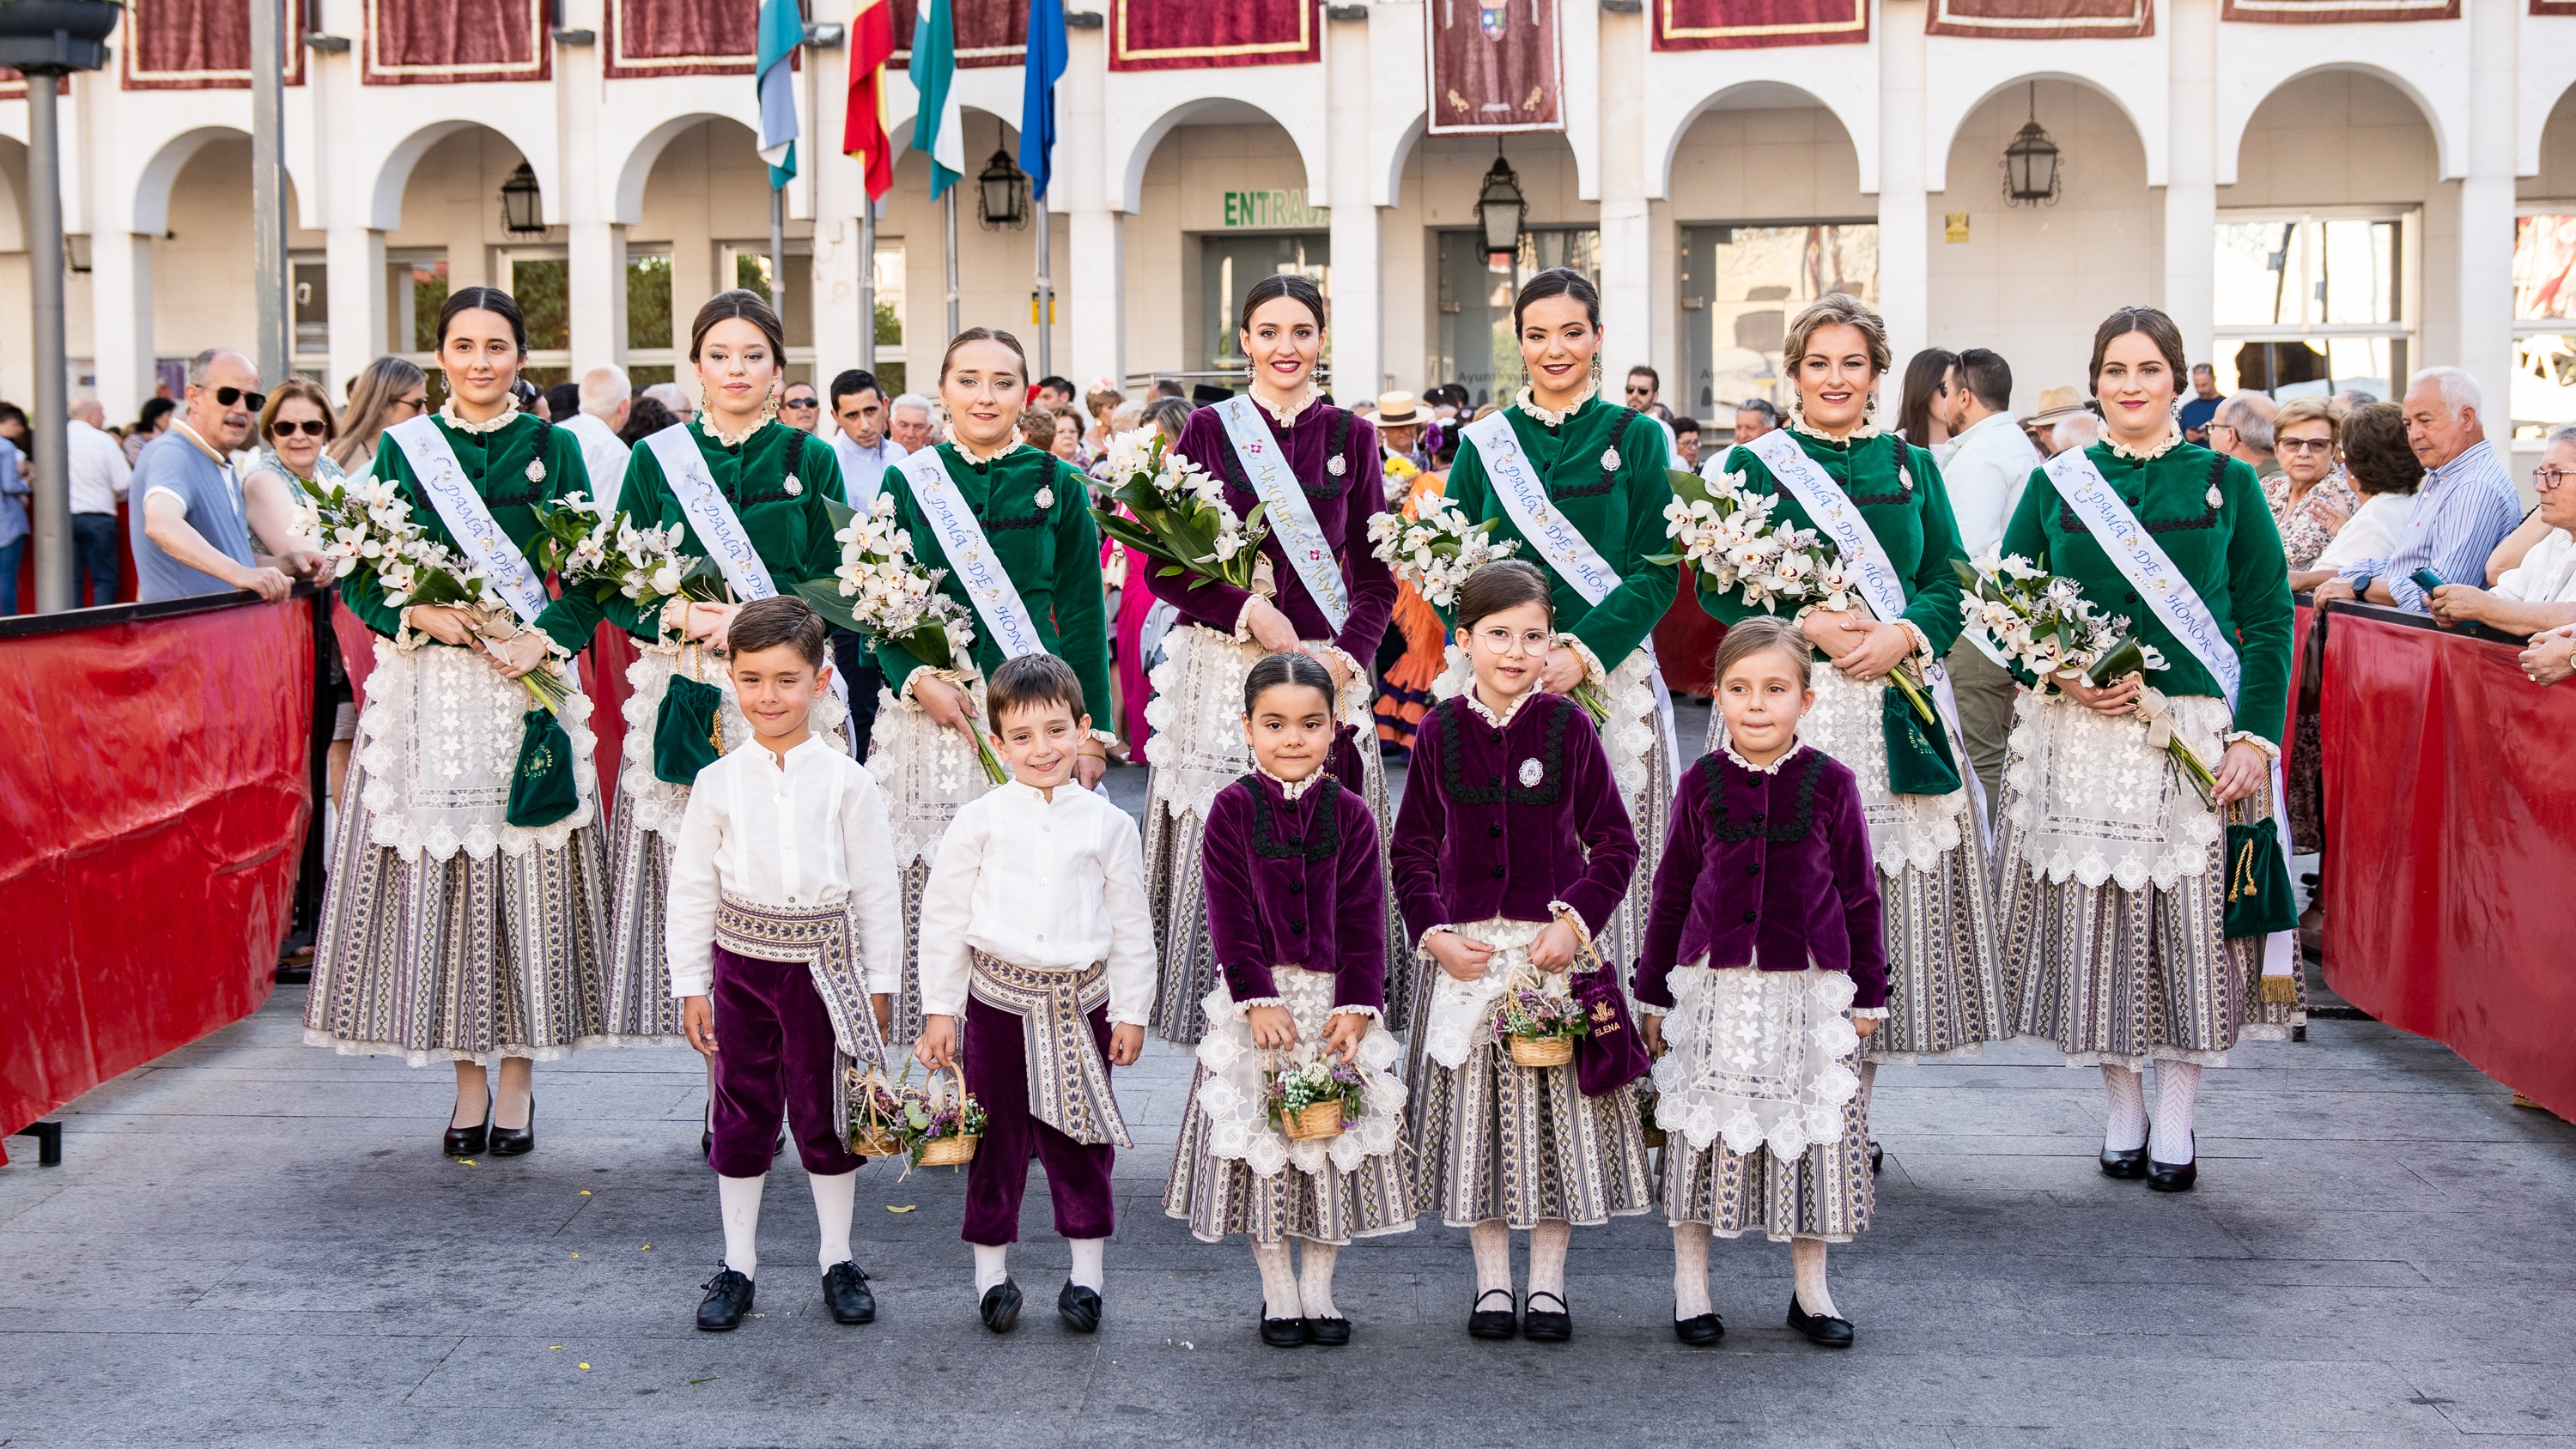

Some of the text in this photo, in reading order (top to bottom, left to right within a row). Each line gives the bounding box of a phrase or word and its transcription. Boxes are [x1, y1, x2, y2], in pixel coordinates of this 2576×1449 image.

[444, 484, 543, 614] DAMA DE HO
[704, 505, 769, 600] DAMA DE
[1252, 464, 1306, 551] ARACELITANA
[1504, 466, 1609, 599] DAMA DE HON
[1791, 466, 1832, 507] DAMA
[1836, 521, 1862, 549] DE
[931, 498, 1030, 655] DAMA DE HONO
[1306, 561, 1340, 617] MAYOR
[2088, 492, 2129, 539] DAMA
[2134, 550, 2162, 577] DE
[2165, 594, 2212, 657] HONOR
[531, 745, 553, 767] ARELITANA
[1595, 1022, 1620, 1037] ELENA
